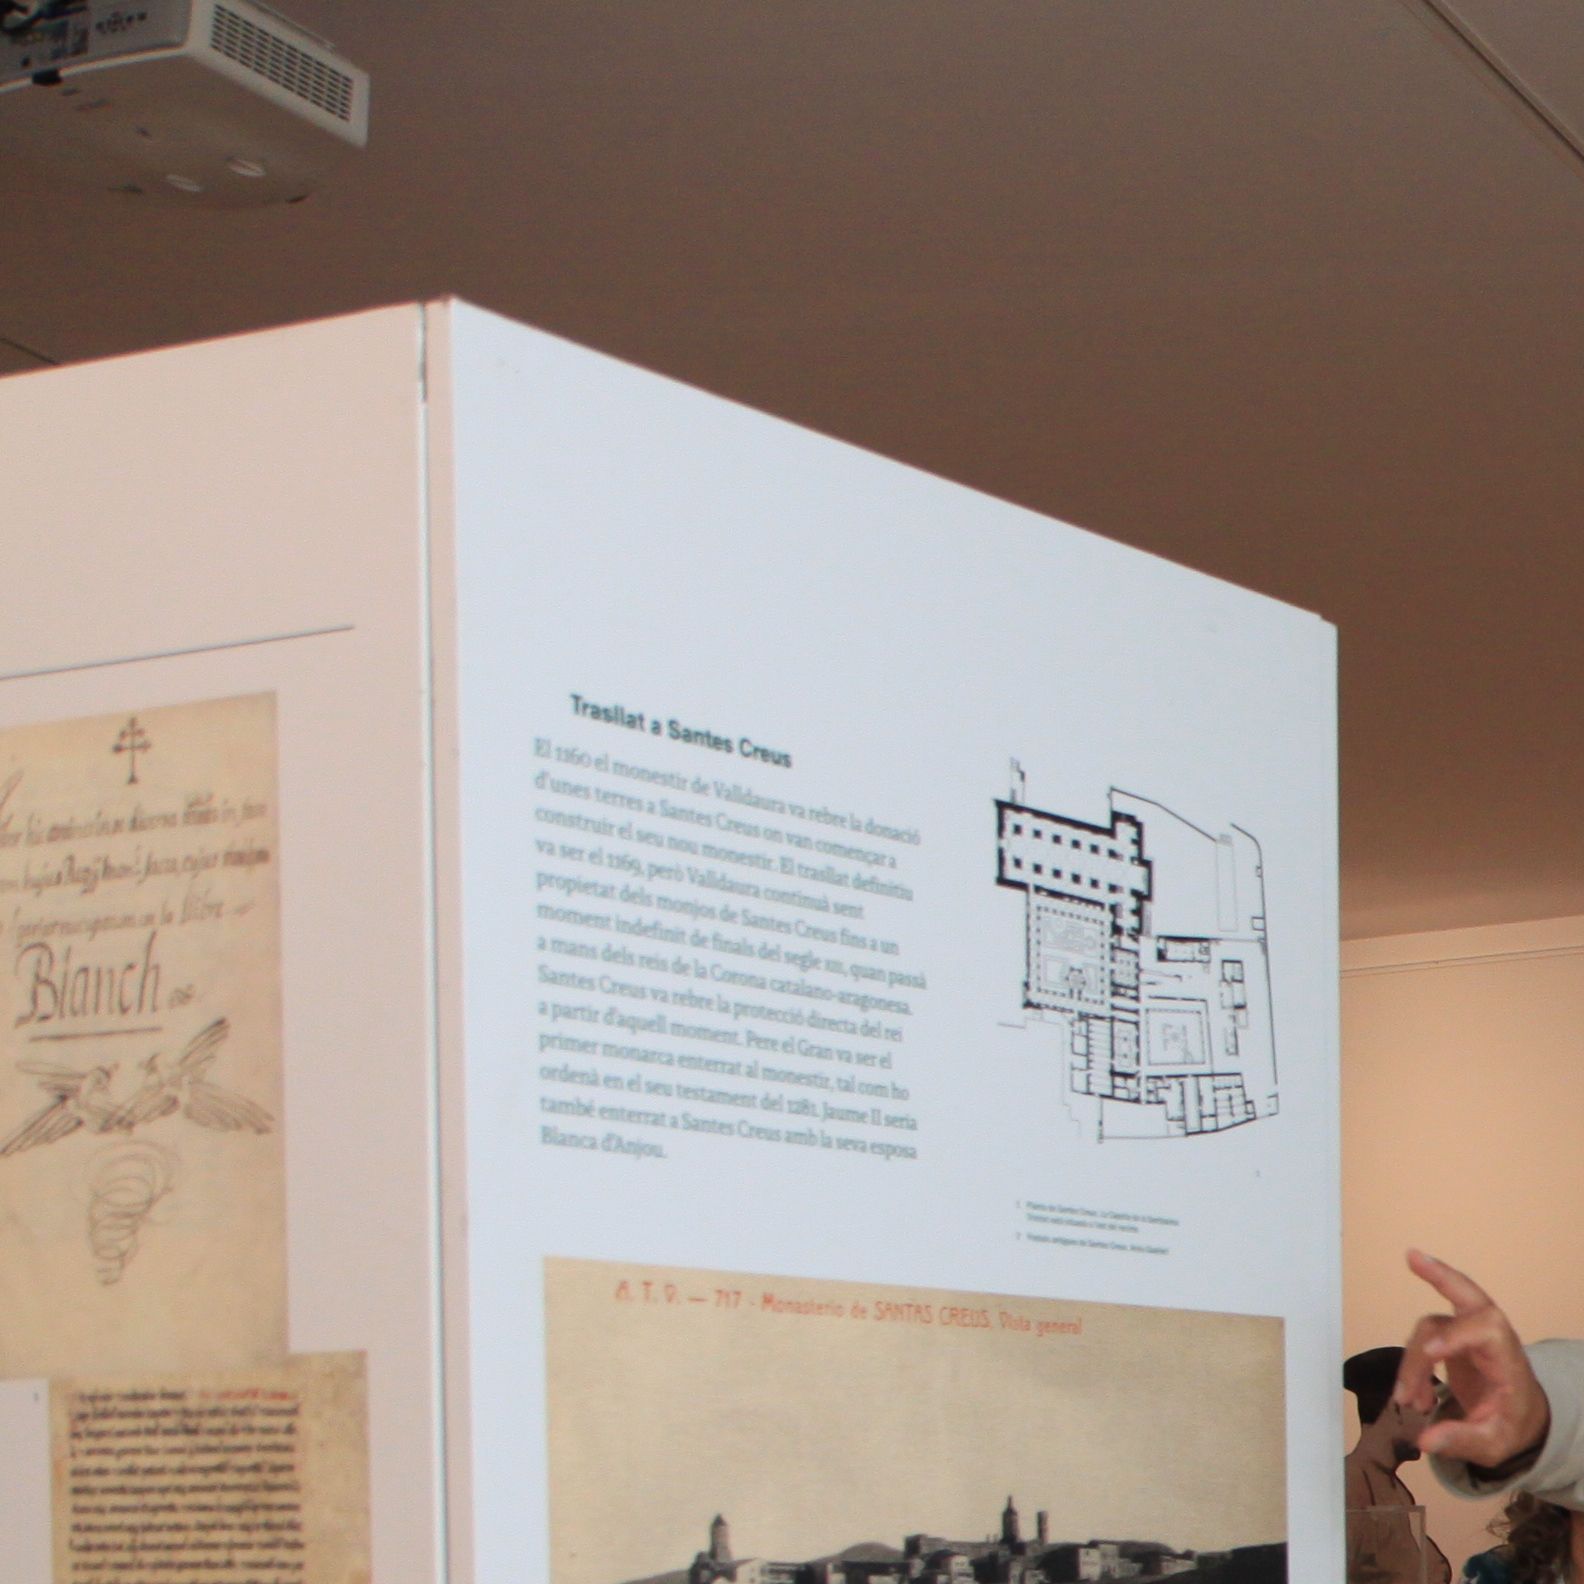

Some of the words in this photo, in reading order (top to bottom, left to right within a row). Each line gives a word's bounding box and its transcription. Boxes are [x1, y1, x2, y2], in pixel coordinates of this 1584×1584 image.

[571, 693, 646, 732] Trasllat
[651, 719, 662, 735] a
[667, 719, 734, 754] Santes
[739, 738, 792, 769] Creus
[873, 1300, 932, 1324] SANTAS
